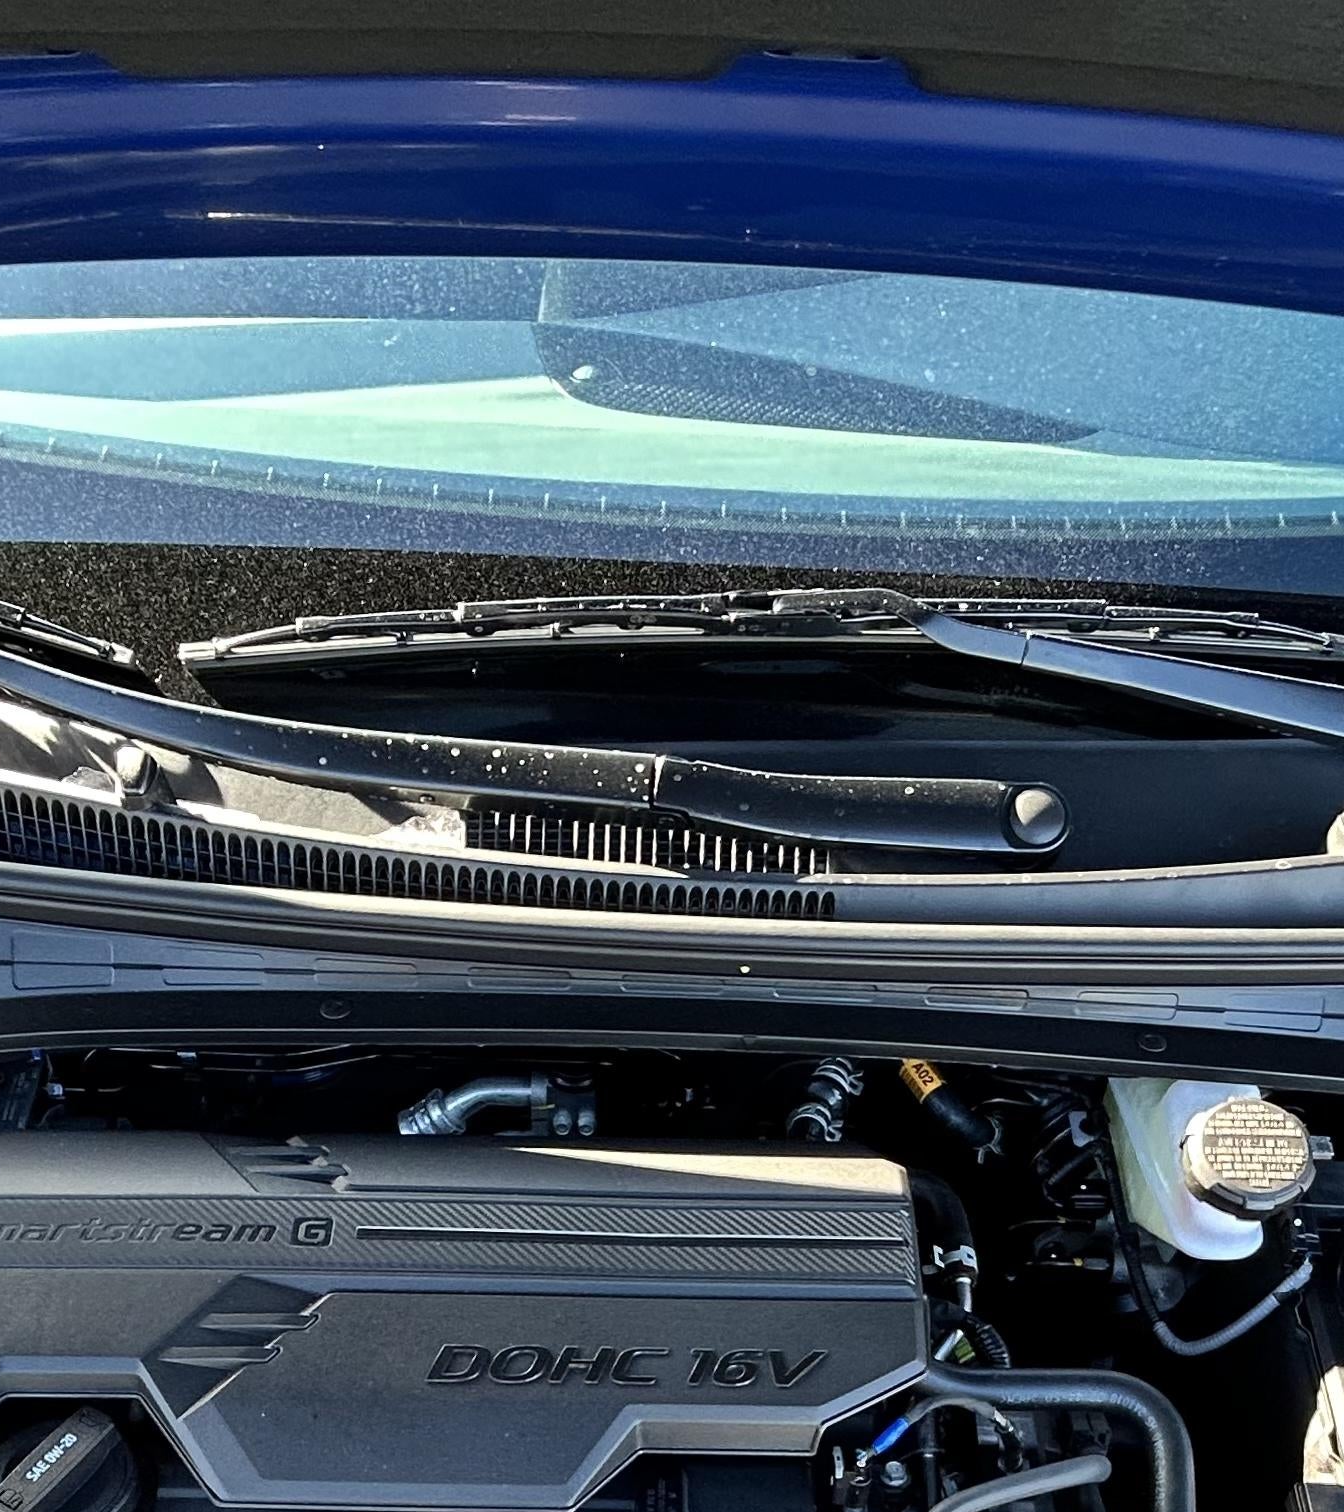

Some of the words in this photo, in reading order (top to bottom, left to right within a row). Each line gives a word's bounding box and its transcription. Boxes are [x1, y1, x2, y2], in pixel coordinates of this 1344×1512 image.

[912, 1063, 935, 1087] A02
[424, 1343, 671, 1386] DOHC
[687, 1347, 829, 1388] 16V
[25, 1460, 51, 1482] SAE
[43, 1432, 78, 1464] 0W-20
